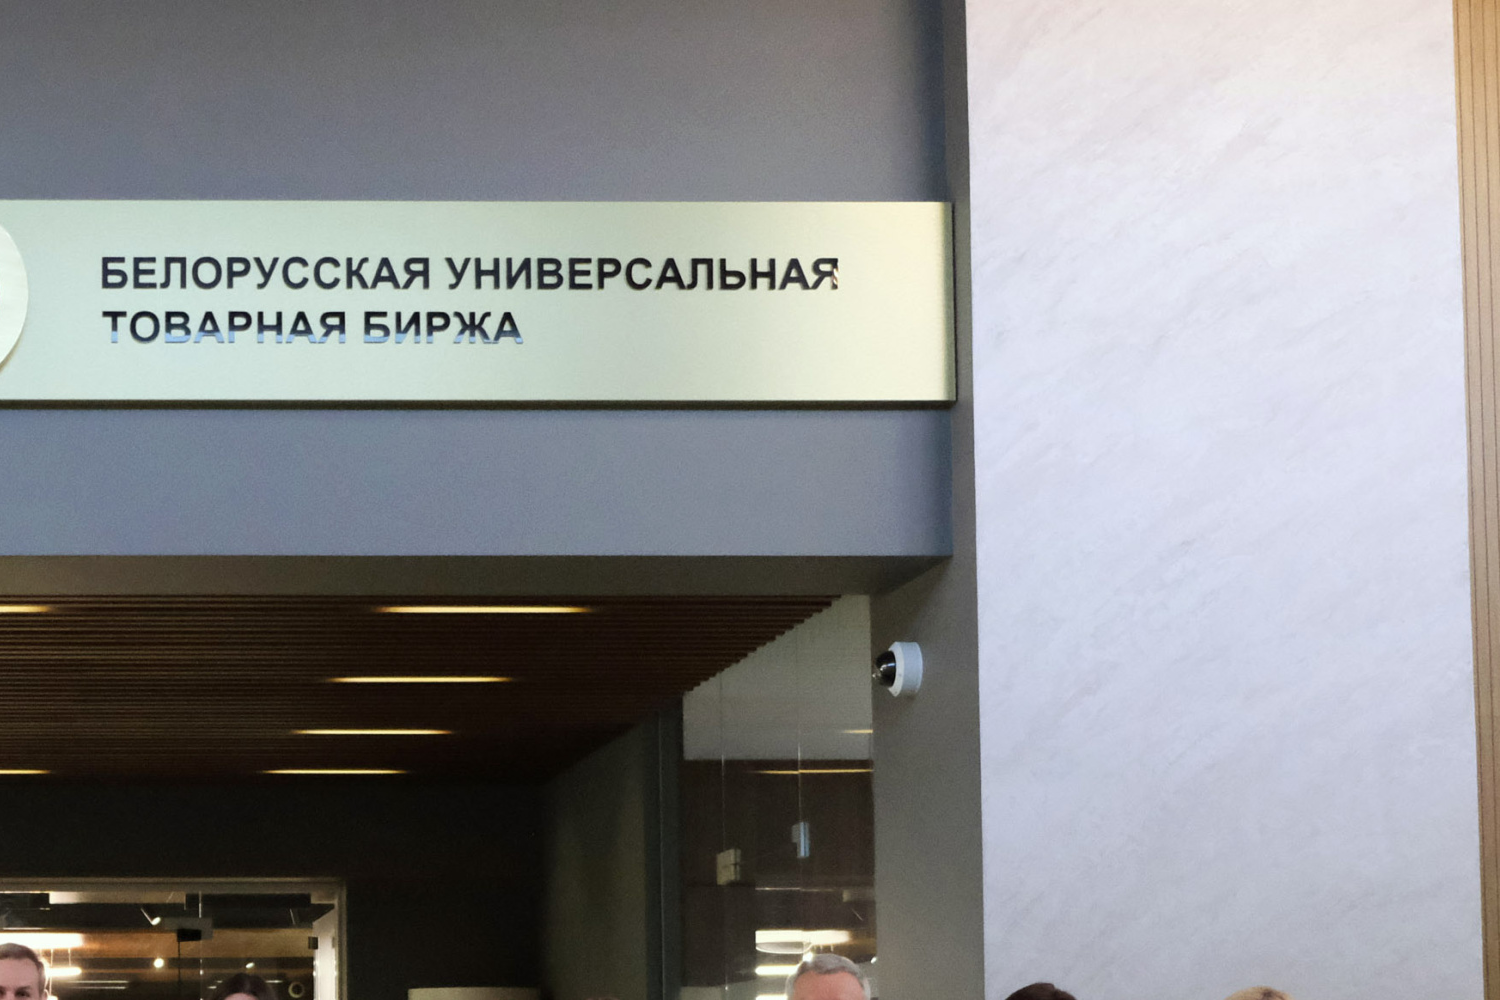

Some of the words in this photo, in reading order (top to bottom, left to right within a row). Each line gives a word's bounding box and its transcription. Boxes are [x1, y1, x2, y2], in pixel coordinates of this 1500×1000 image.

[101, 256, 430, 290] БЕЛОРУССКАЯ
[445, 257, 839, 291] УНИВЕРСАЛЬНАЯ
[102, 311, 346, 344] ТОВАРНАЯ
[363, 311, 524, 345] БИРЖА
